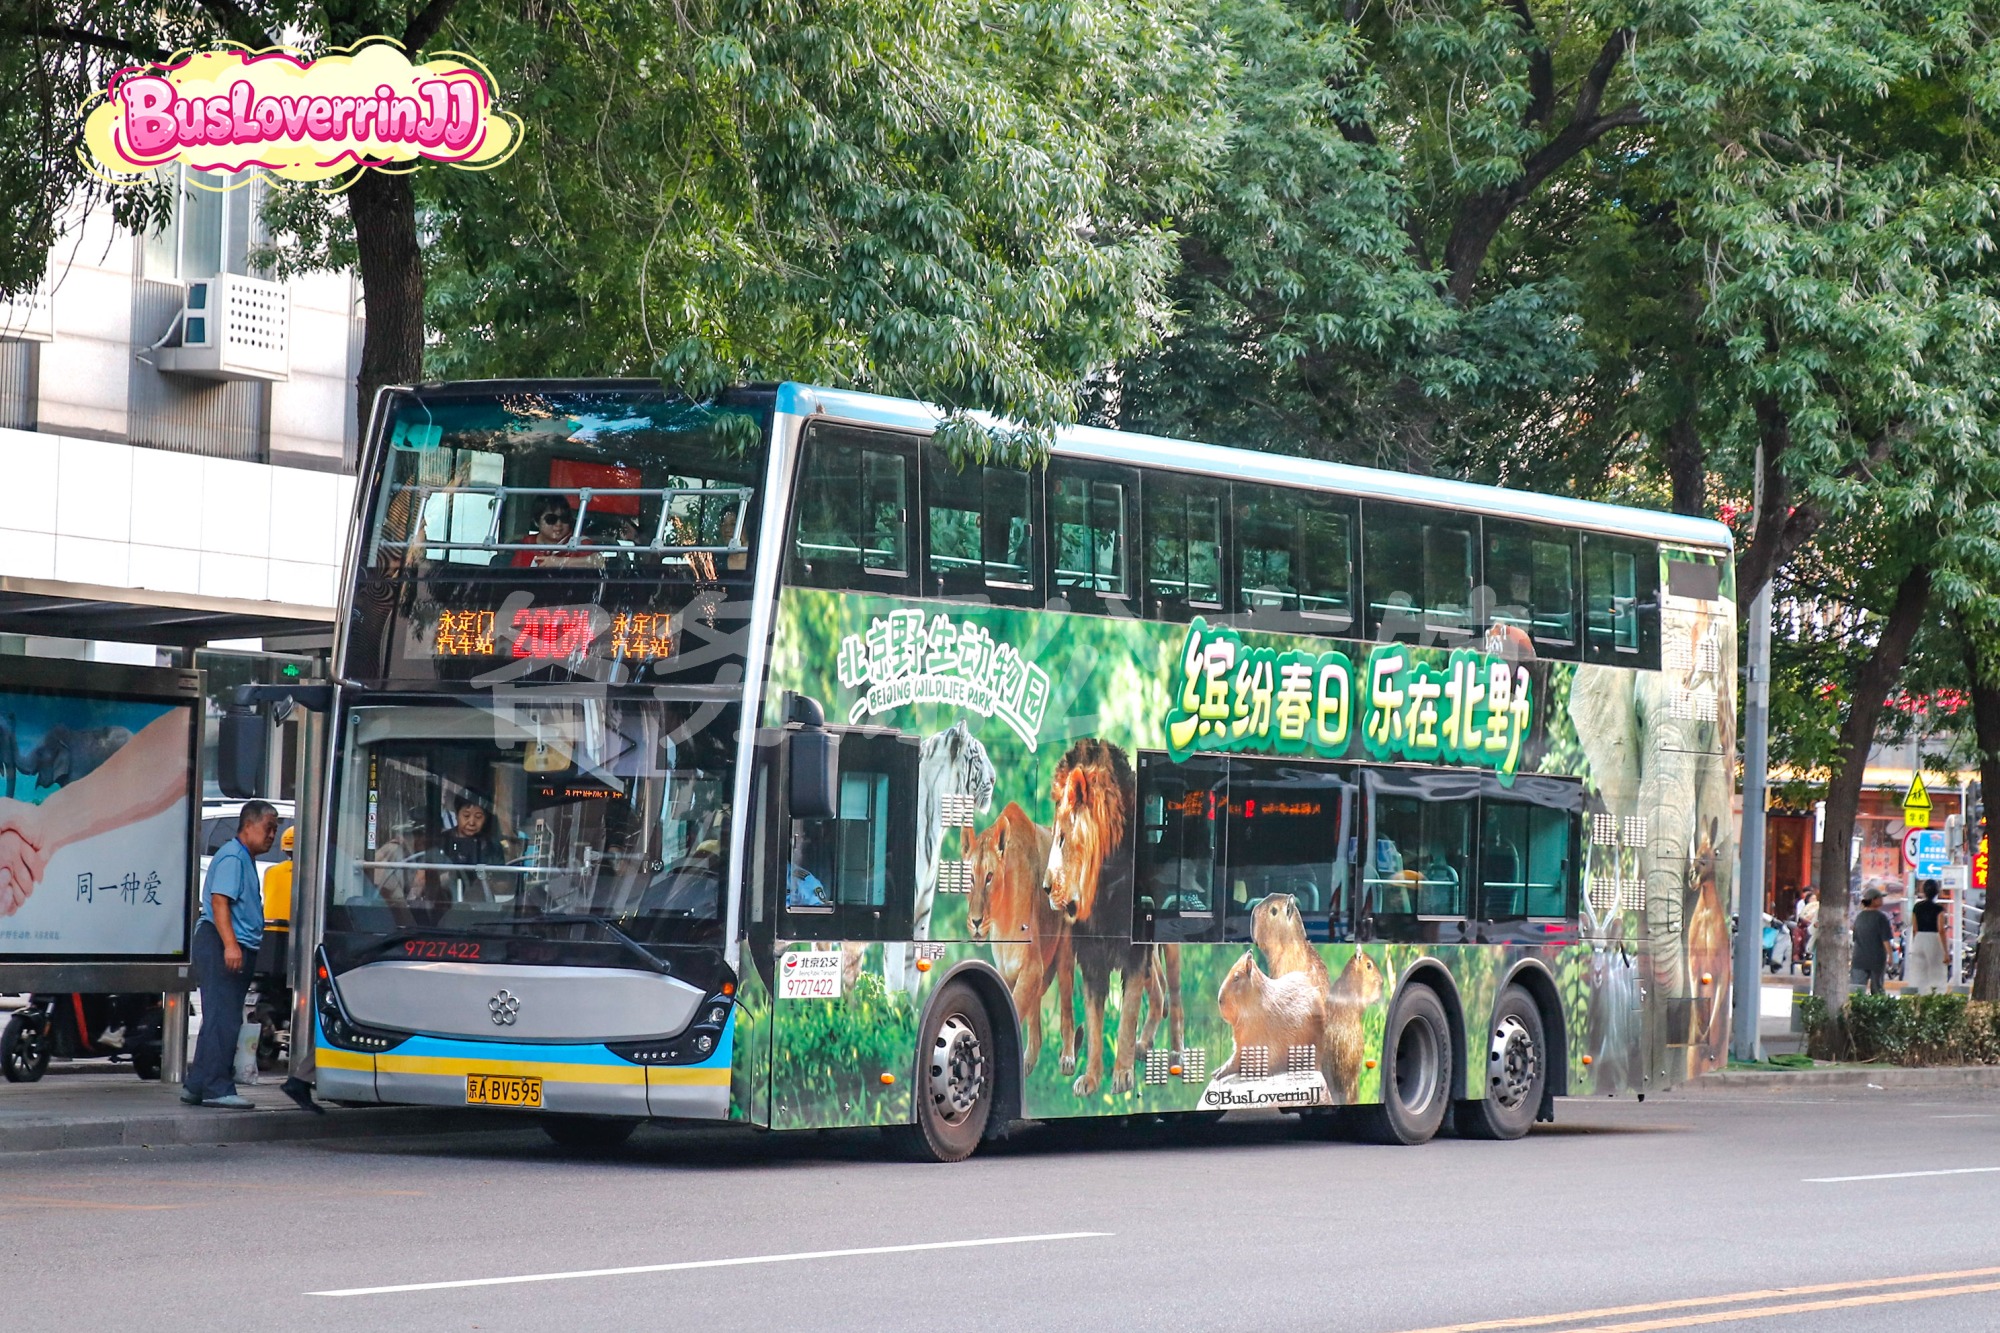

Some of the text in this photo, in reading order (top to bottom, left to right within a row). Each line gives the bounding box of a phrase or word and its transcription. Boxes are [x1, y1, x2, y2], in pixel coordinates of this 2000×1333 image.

[438, 609, 495, 632] 永定门
[613, 612, 671, 635] 永定门
[437, 632, 495, 656] 汽车站
[611, 635, 670, 658] 汽车站
[838, 609, 1050, 736] 北京野生动物园
[869, 680, 994, 712] BEIJING WILDLIFE PARK
[1170, 629, 1530, 775] 缤纷春日 乐在北野
[1909, 813, 1926, 823] 学校
[76, 872, 163, 907] 同一种爱
[404, 940, 480, 959] 9727422
[800, 957, 839, 968] 北京公交
[787, 978, 833, 996] 9727422
